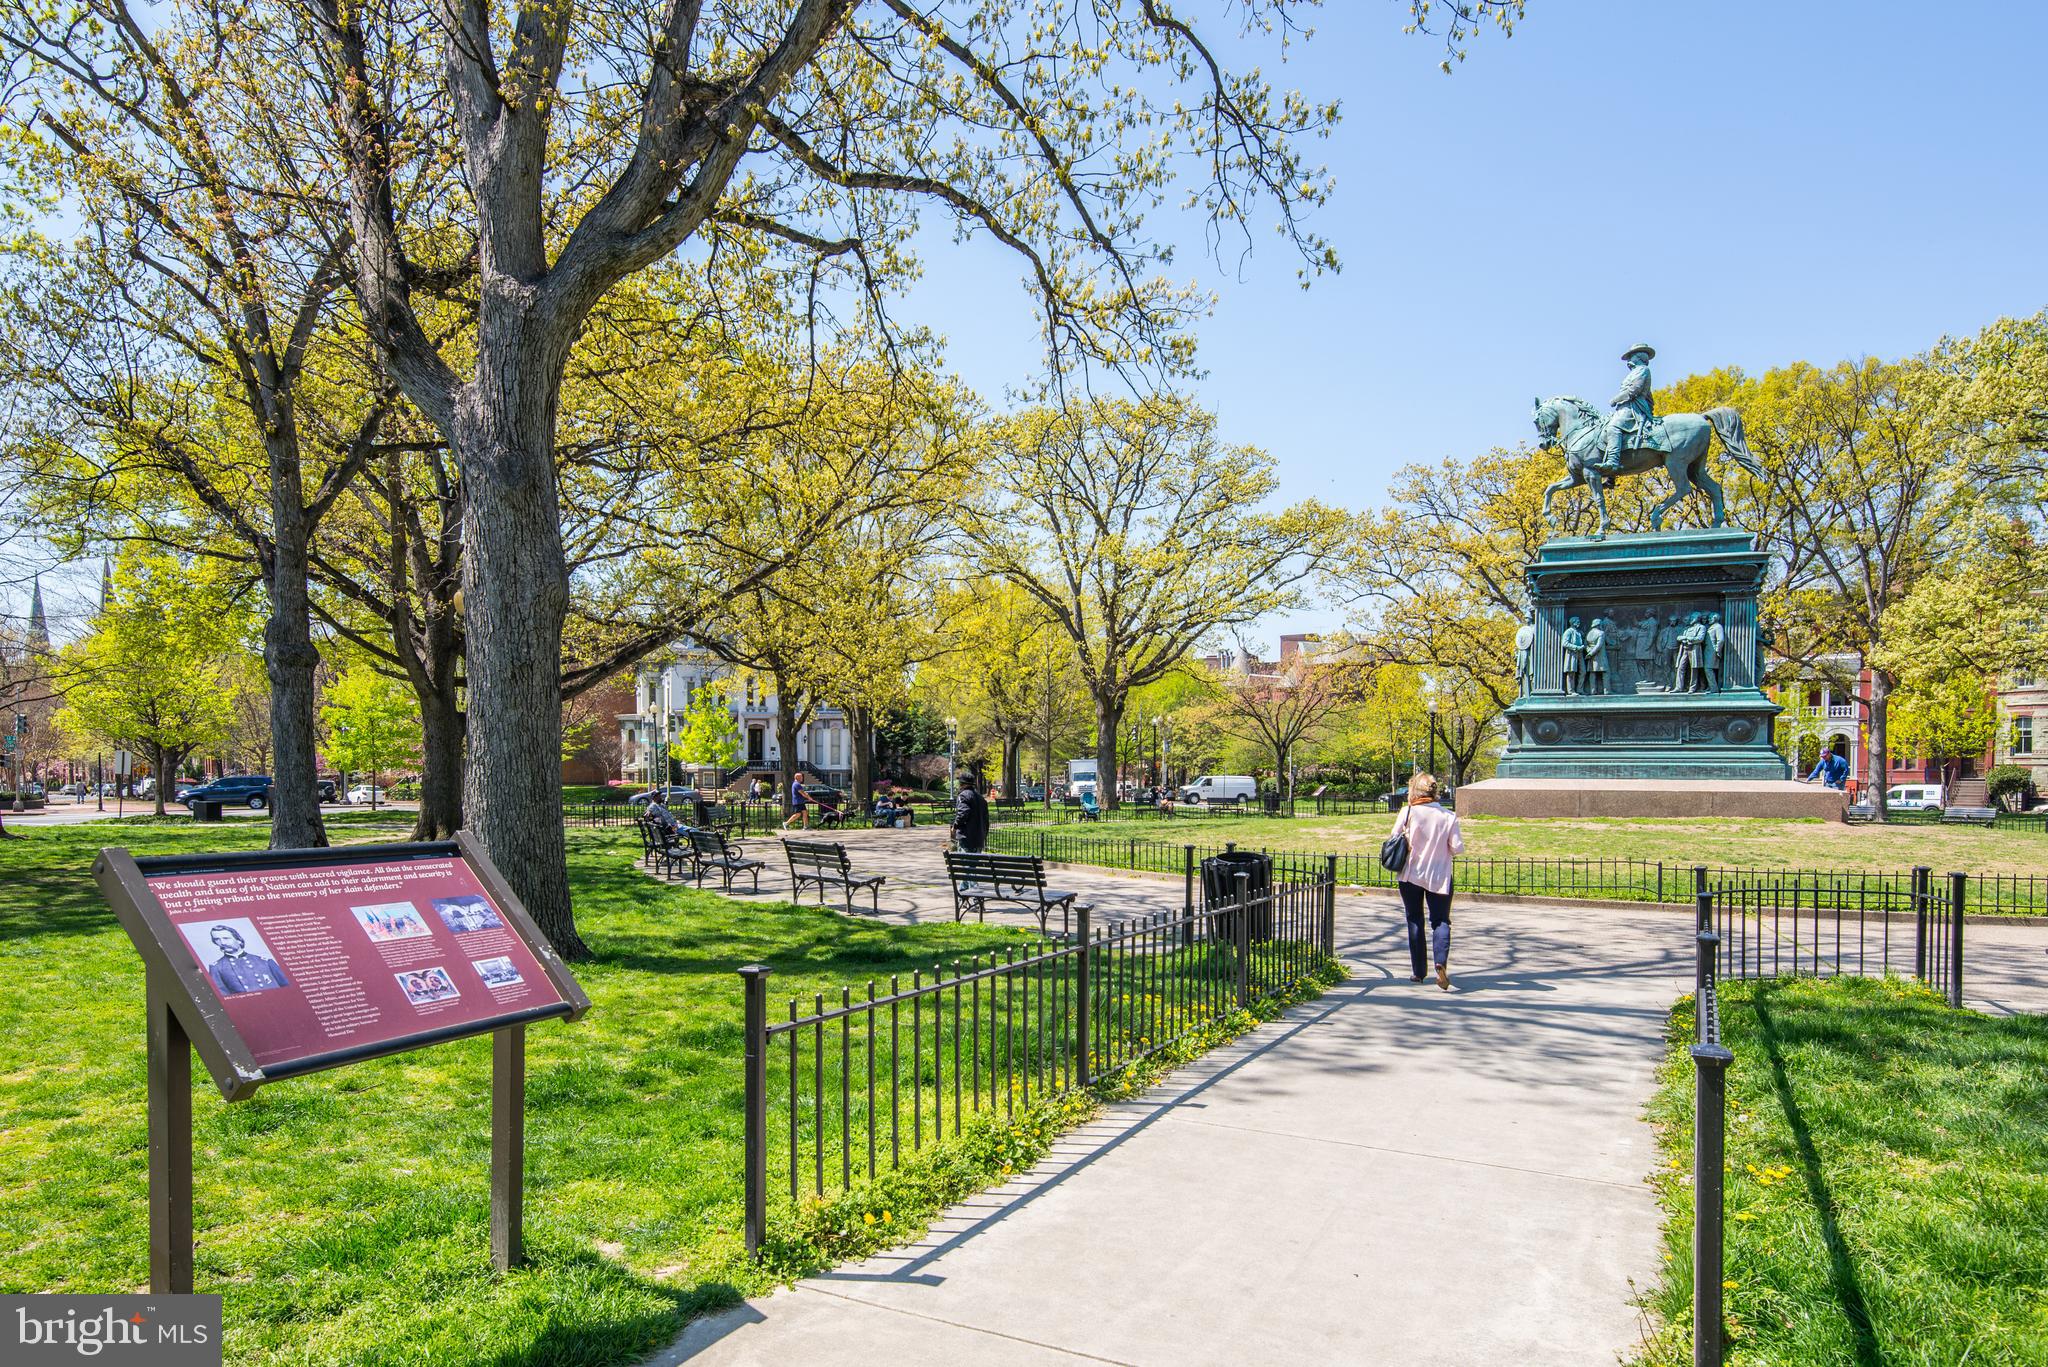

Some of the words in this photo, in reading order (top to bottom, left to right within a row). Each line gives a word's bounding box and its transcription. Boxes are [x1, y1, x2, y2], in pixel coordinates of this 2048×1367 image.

[174, 880, 205, 891] should
[207, 878, 235, 888] guard
[237, 876, 257, 885] their
[260, 876, 288, 884] graves
[310, 870, 335, 878] sacred
[336, 869, 372, 877] vigilance.
[414, 862, 453, 870] consecrated
[158, 890, 192, 900] wealth
[195, 888, 214, 899] and
[215, 888, 237, 896] taste
[239, 885, 248, 894] of
[265, 883, 296, 893] Nation
[164, 901, 182, 909] but
[185, 901, 191, 909] a
[193, 898, 223, 908] fitting
[224, 895, 254, 903] tribute
[319, 888, 327, 896] of
